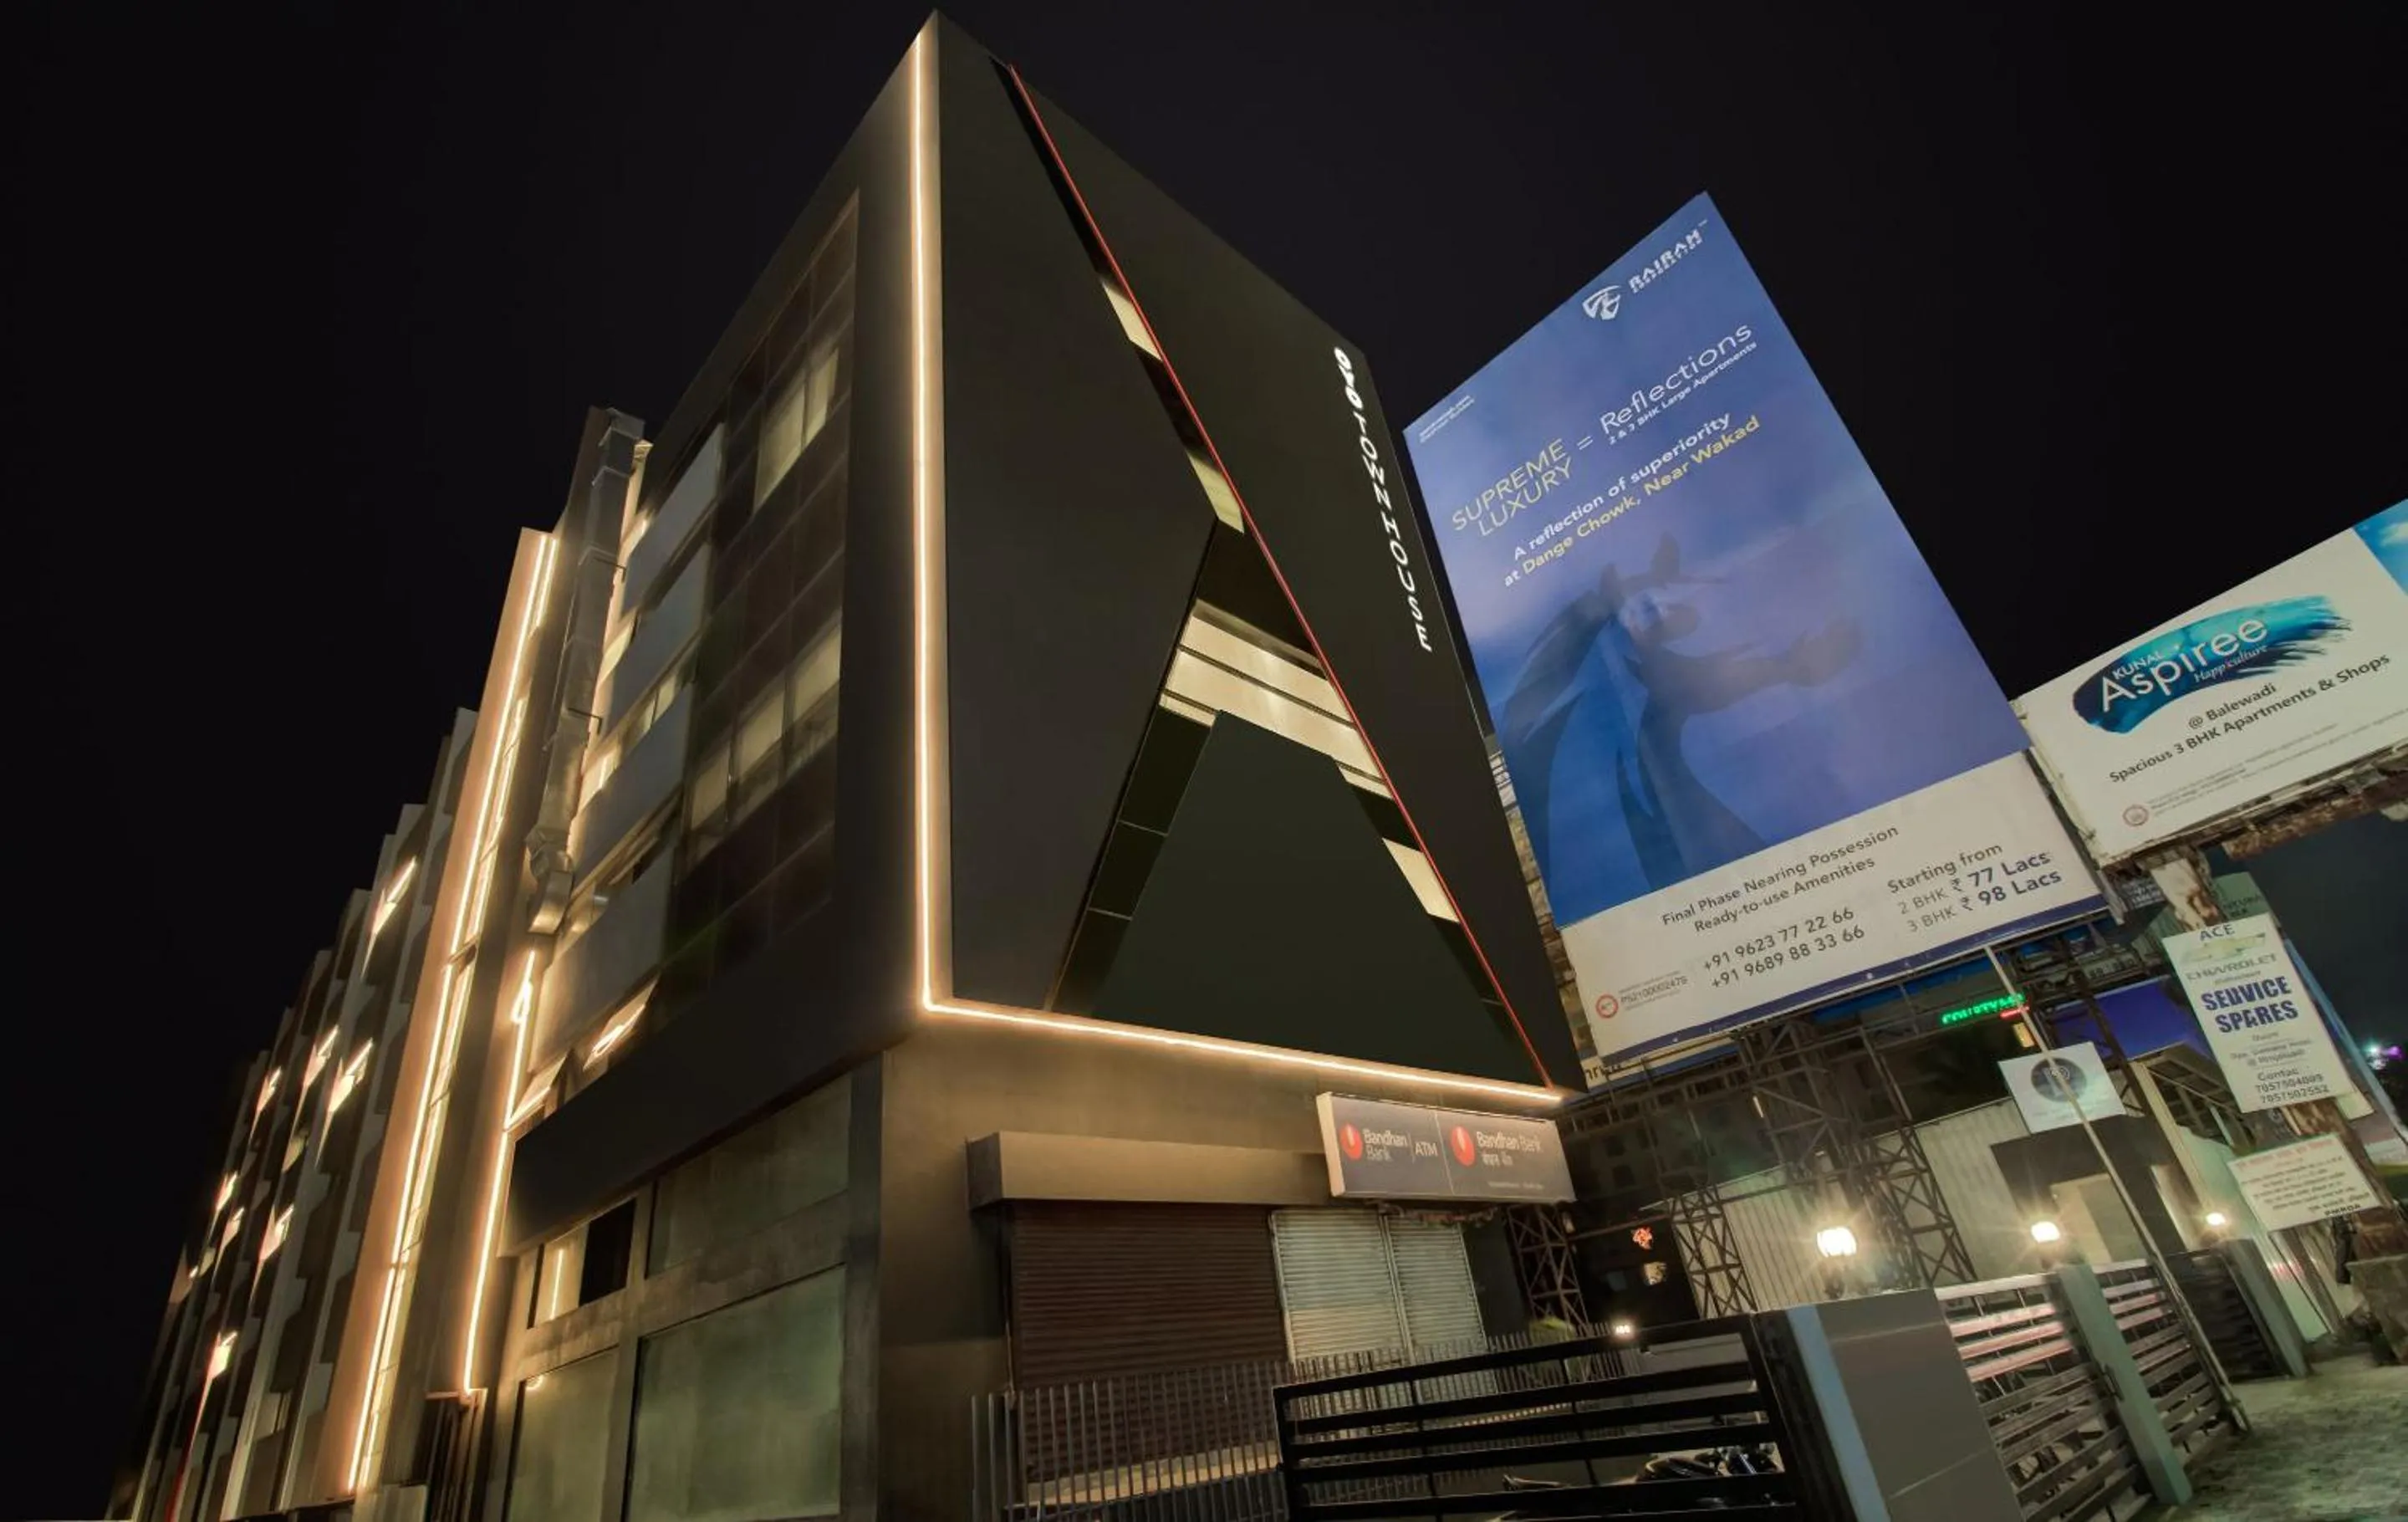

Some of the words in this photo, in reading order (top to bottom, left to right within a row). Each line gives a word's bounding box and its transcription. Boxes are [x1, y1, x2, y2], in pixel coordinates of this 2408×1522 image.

[1599, 325, 1752, 433] Reflections
[1638, 407, 1660, 428] BHK
[1661, 386, 1691, 411] Large
[1692, 341, 1758, 390] Apartments
[1451, 437, 1567, 532] SUPREME
[1478, 456, 1572, 537] LUXURY
[1505, 569, 1522, 586] at
[1523, 535, 1574, 575] Dange
[1576, 495, 1641, 538] Chowk,
[1644, 462, 1691, 497] Near
[1691, 415, 1760, 464] Wakad
[1514, 546, 1528, 560] A
[1528, 494, 1604, 550] reflection
[1608, 476, 1627, 498] of
[1630, 412, 1731, 484] superiority
[1354, 411, 1432, 652] TOWNHOUSE
[2101, 619, 2268, 713] Aspiree
[2112, 649, 2166, 681] KUNAL
[2110, 750, 2174, 784] Spacious
[2174, 742, 2185, 755] 3
[2185, 727, 2222, 750] BHK
[2222, 686, 2317, 734] Apartments
[2318, 678, 2336, 692] &
[2336, 654, 2391, 683] Shops
[2188, 715, 2204, 730] @
[2205, 682, 2278, 723] Balewadi
[1662, 903, 1696, 926] Final
[1698, 887, 1742, 912] Phase
[1743, 861, 1808, 894] Nearing
[1809, 825, 1900, 867] Possession
[1694, 888, 1790, 932] Ready-to-use
[1793, 857, 1875, 896] Amenities
[1887, 860, 1957, 894] Starting
[1959, 844, 2003, 867] from
[1897, 900, 1908, 915] 2
[1912, 886, 1949, 911] BHK
[1967, 866, 1994, 887] 77
[2000, 851, 2052, 876] Lacs
[1906, 919, 1918, 933] 3
[1922, 906, 1957, 928] BHK
[1978, 886, 2007, 906] 98
[2010, 870, 2063, 895] Lacs
[1703, 950, 1731, 972] +91
[1734, 934, 1776, 958] 9623
[1778, 925, 1799, 943] 77
[1804, 915, 1826, 933] 22
[1831, 906, 1854, 924] 66
[1712, 968, 1740, 989] +91
[1743, 952, 1784, 977] 9689
[1788, 942, 1811, 962] 88
[1814, 932, 1838, 953] 33
[1842, 924, 1865, 942] 66
[2200, 924, 2235, 941] ACE
[2215, 1000, 2299, 1034] SPARES
[1362, 1129, 1409, 1147] Bandhan
[1366, 1146, 1395, 1162] Bank
[1414, 1141, 1439, 1157] ATM
[1477, 1131, 1521, 1152] Bandhan
[1520, 1135, 1543, 1152] Bank
